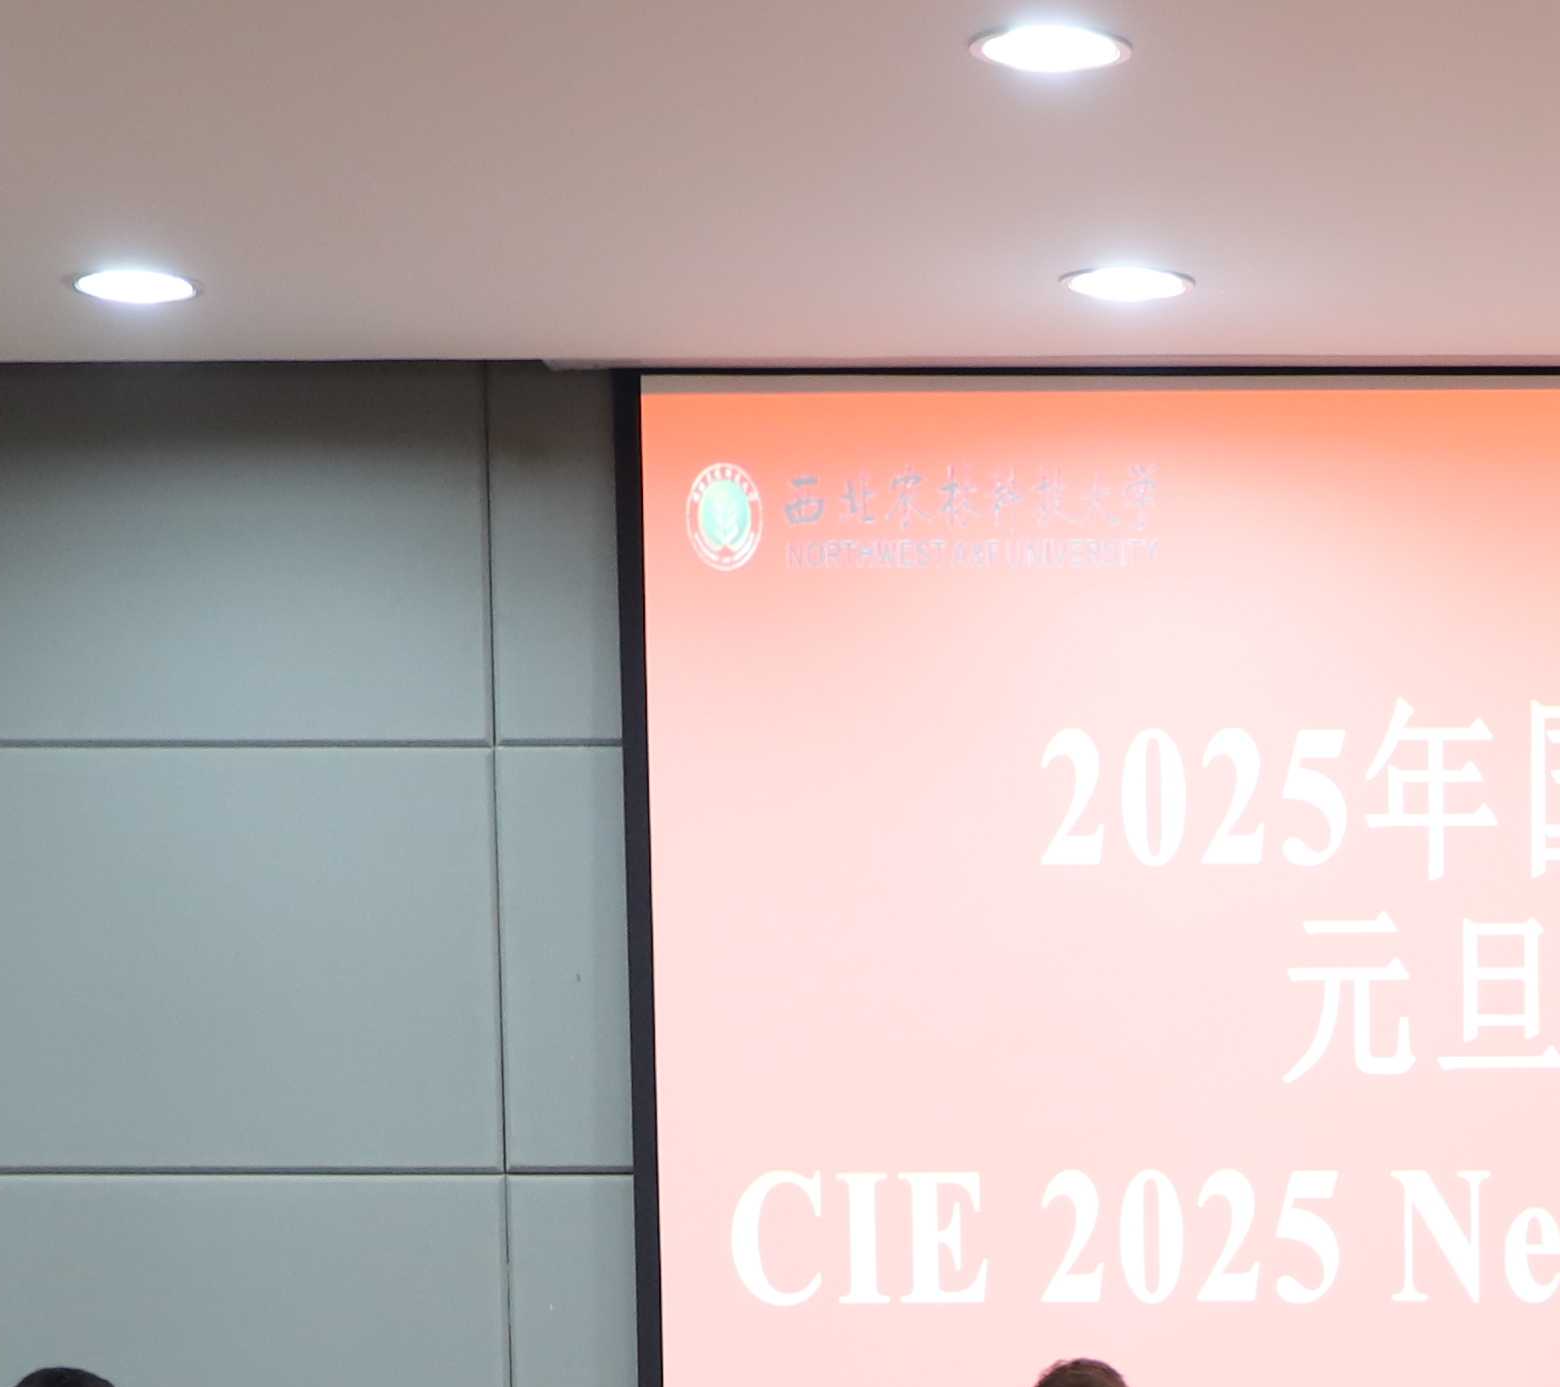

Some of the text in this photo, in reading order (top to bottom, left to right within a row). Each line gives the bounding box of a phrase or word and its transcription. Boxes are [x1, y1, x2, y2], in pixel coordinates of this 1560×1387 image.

[786, 538, 944, 570] NORTHWEST
[1008, 538, 1160, 570] UNIVERSITY
[730, 1168, 990, 1306] CIE
[1040, 1168, 1341, 1305] 2025
